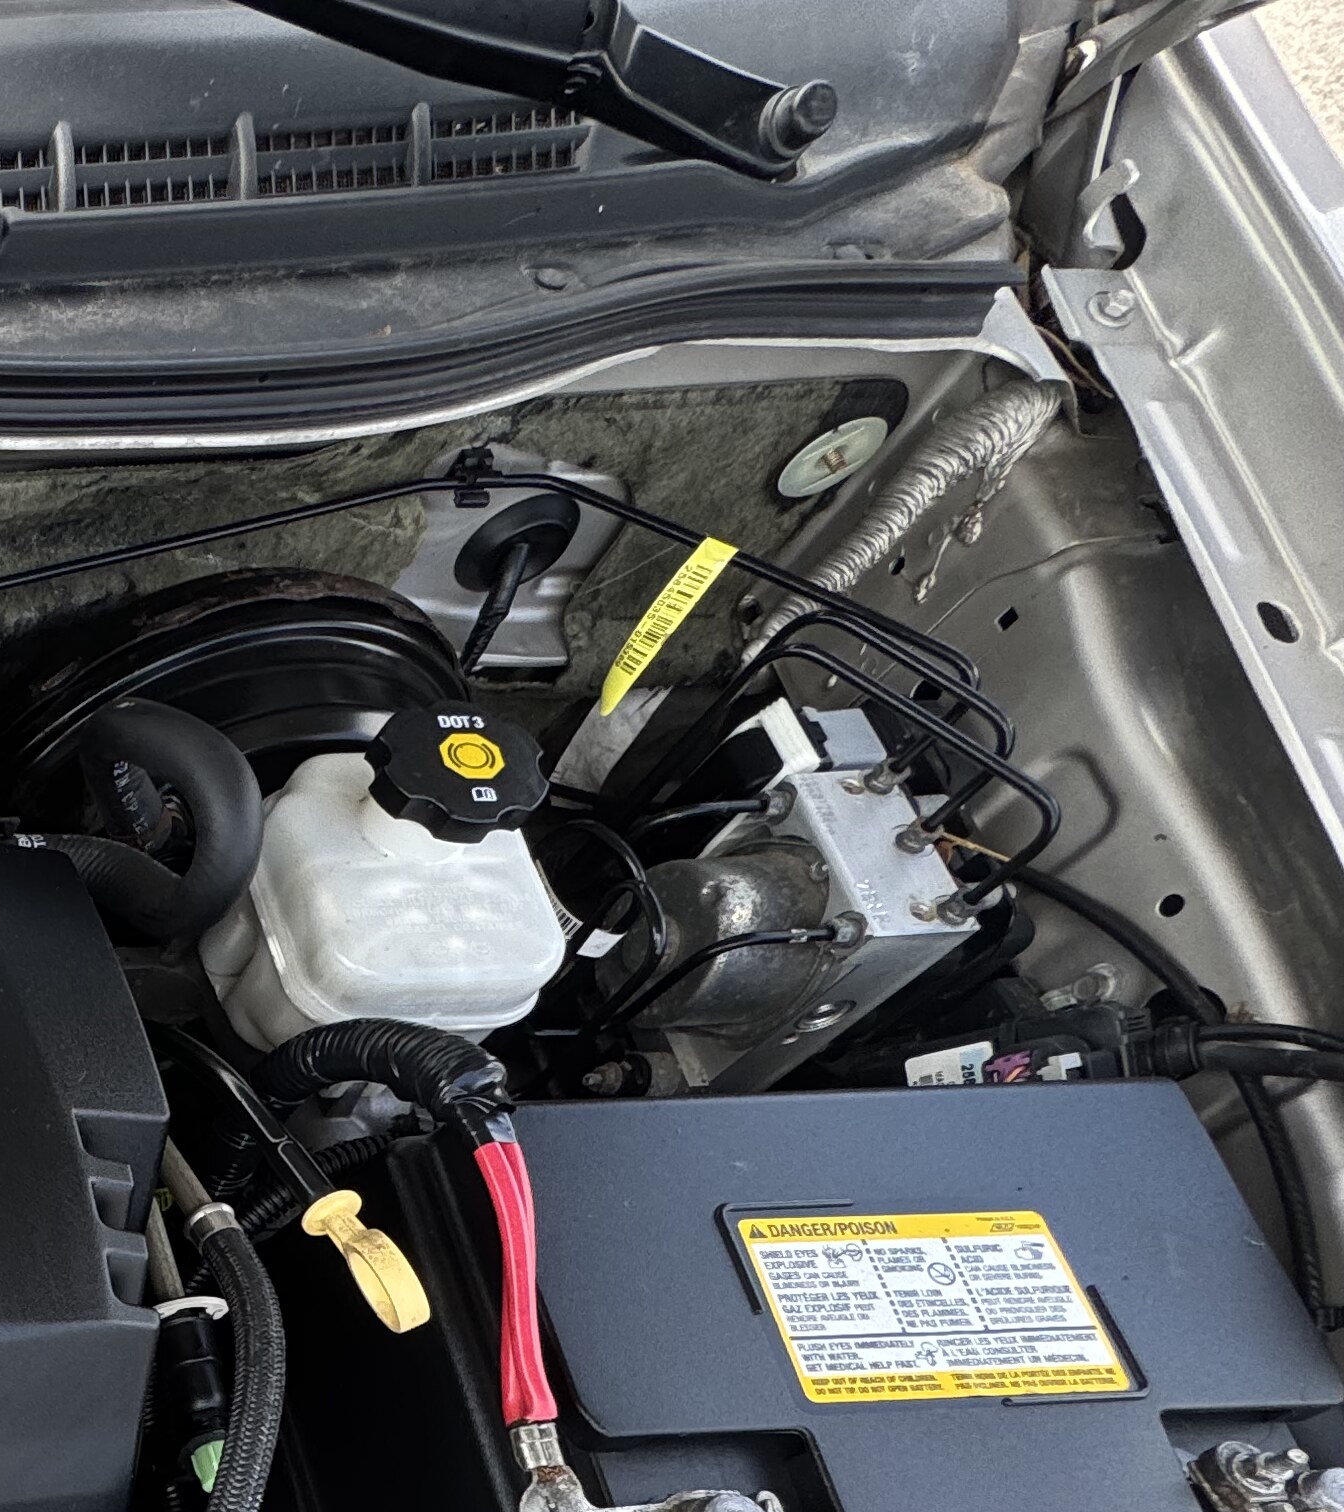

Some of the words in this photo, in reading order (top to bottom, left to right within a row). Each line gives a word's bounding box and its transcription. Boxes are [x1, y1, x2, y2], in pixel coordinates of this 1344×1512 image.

[437, 715, 469, 728] DOT
[472, 716, 484, 728] 3
[766, 1221, 898, 1237] DANGER/POISON
